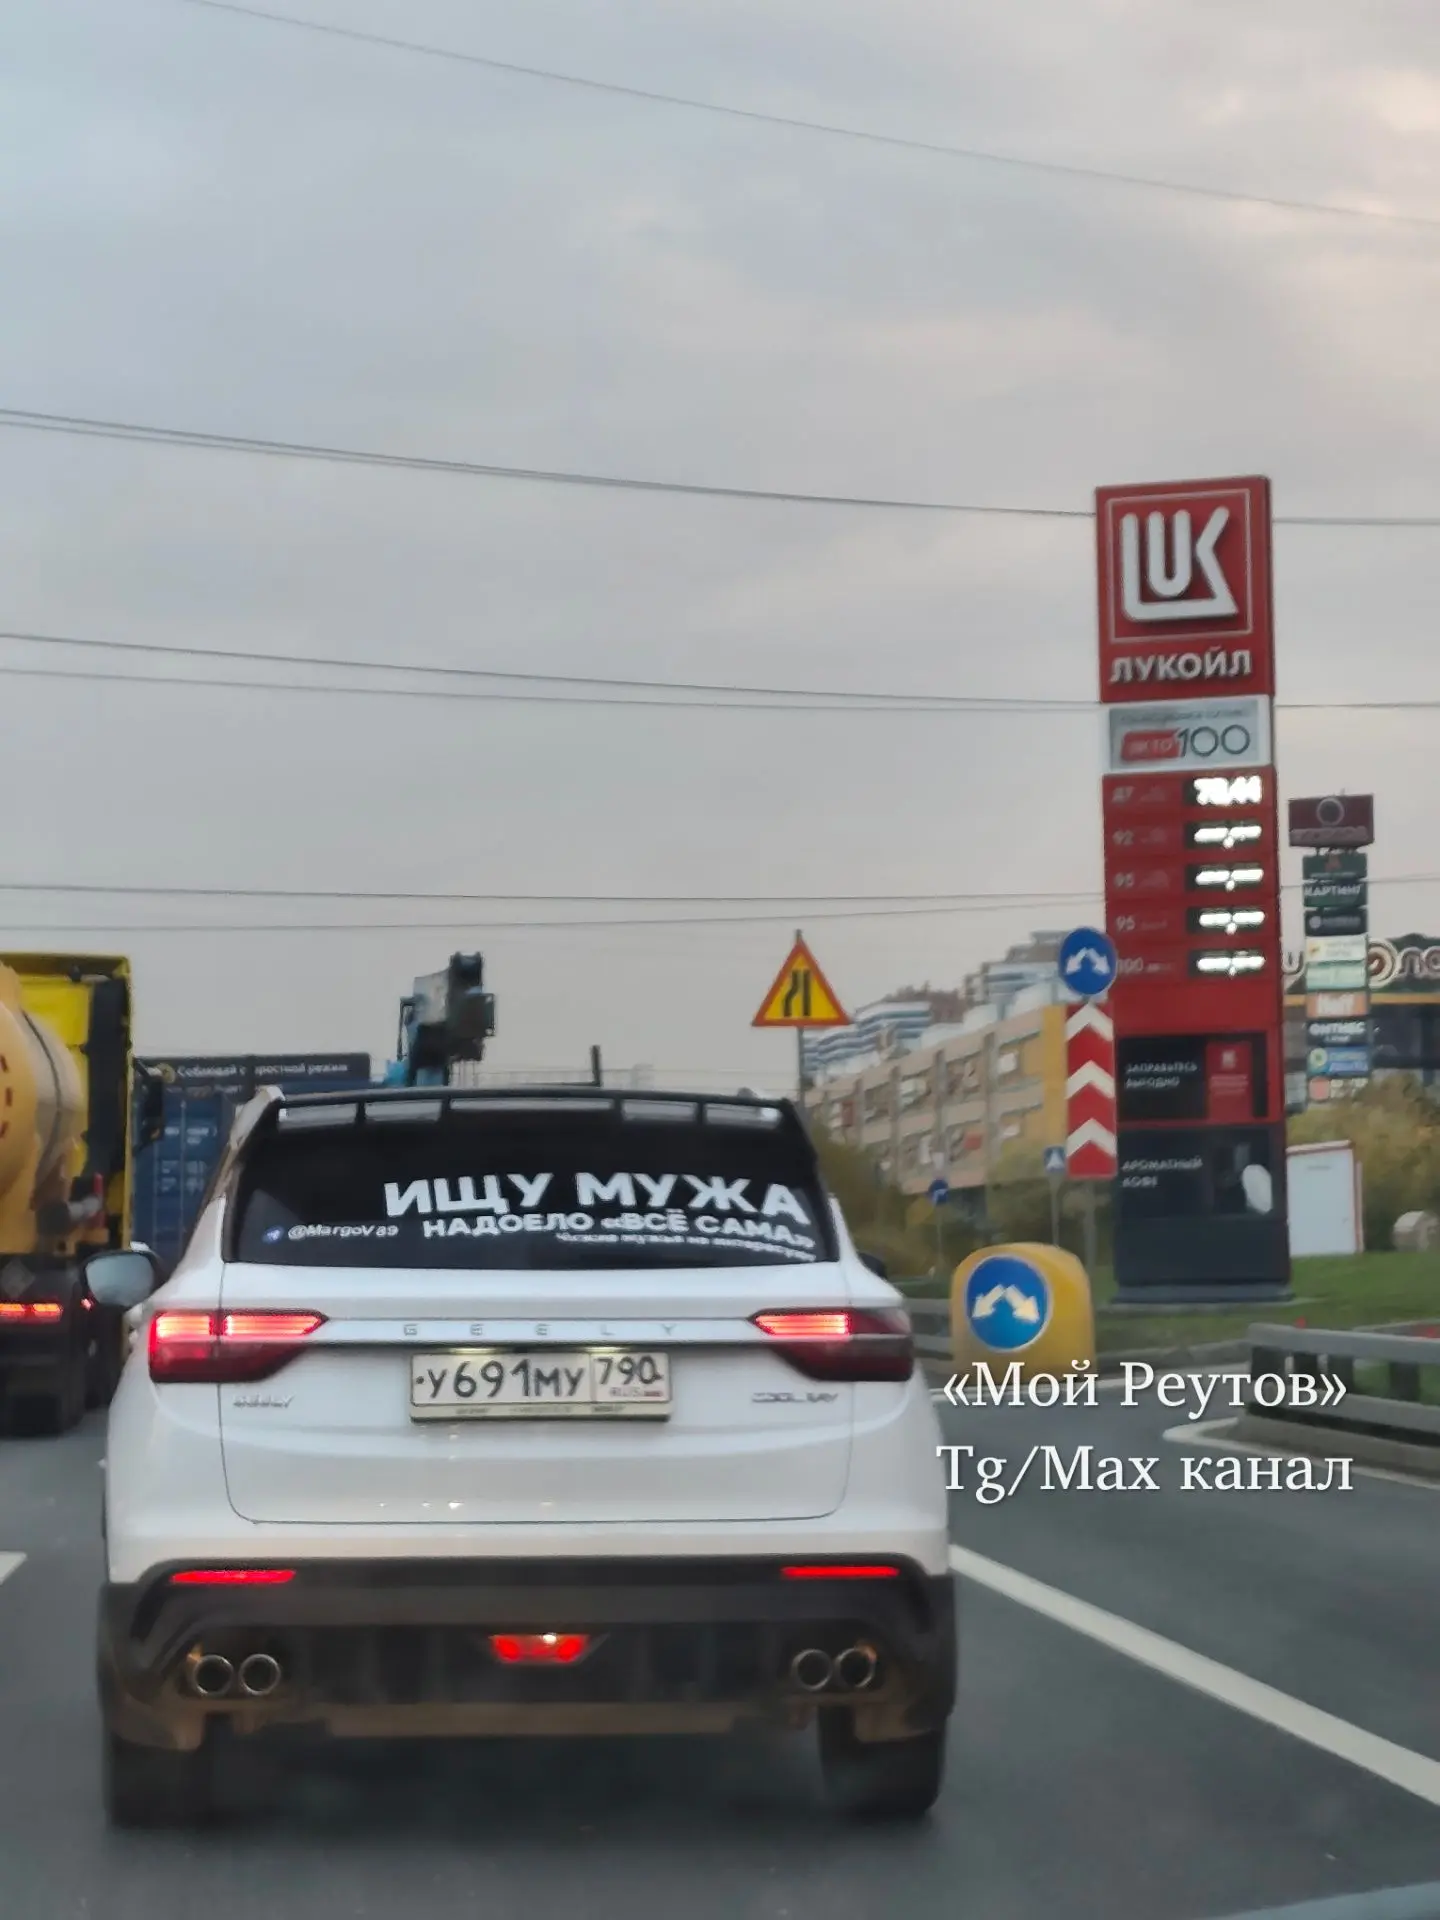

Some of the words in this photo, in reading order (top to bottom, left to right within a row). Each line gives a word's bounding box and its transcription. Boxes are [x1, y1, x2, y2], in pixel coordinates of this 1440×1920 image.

[1108, 645, 1251, 684] ЛУКОЙЛ
[384, 1173, 553, 1217] ИЩУ
[576, 1172, 811, 1225] МУЖА
[423, 1212, 594, 1238] НАДОЕЛО
[404, 1323, 676, 1336] GEELY
[595, 1356, 659, 1385] 790
